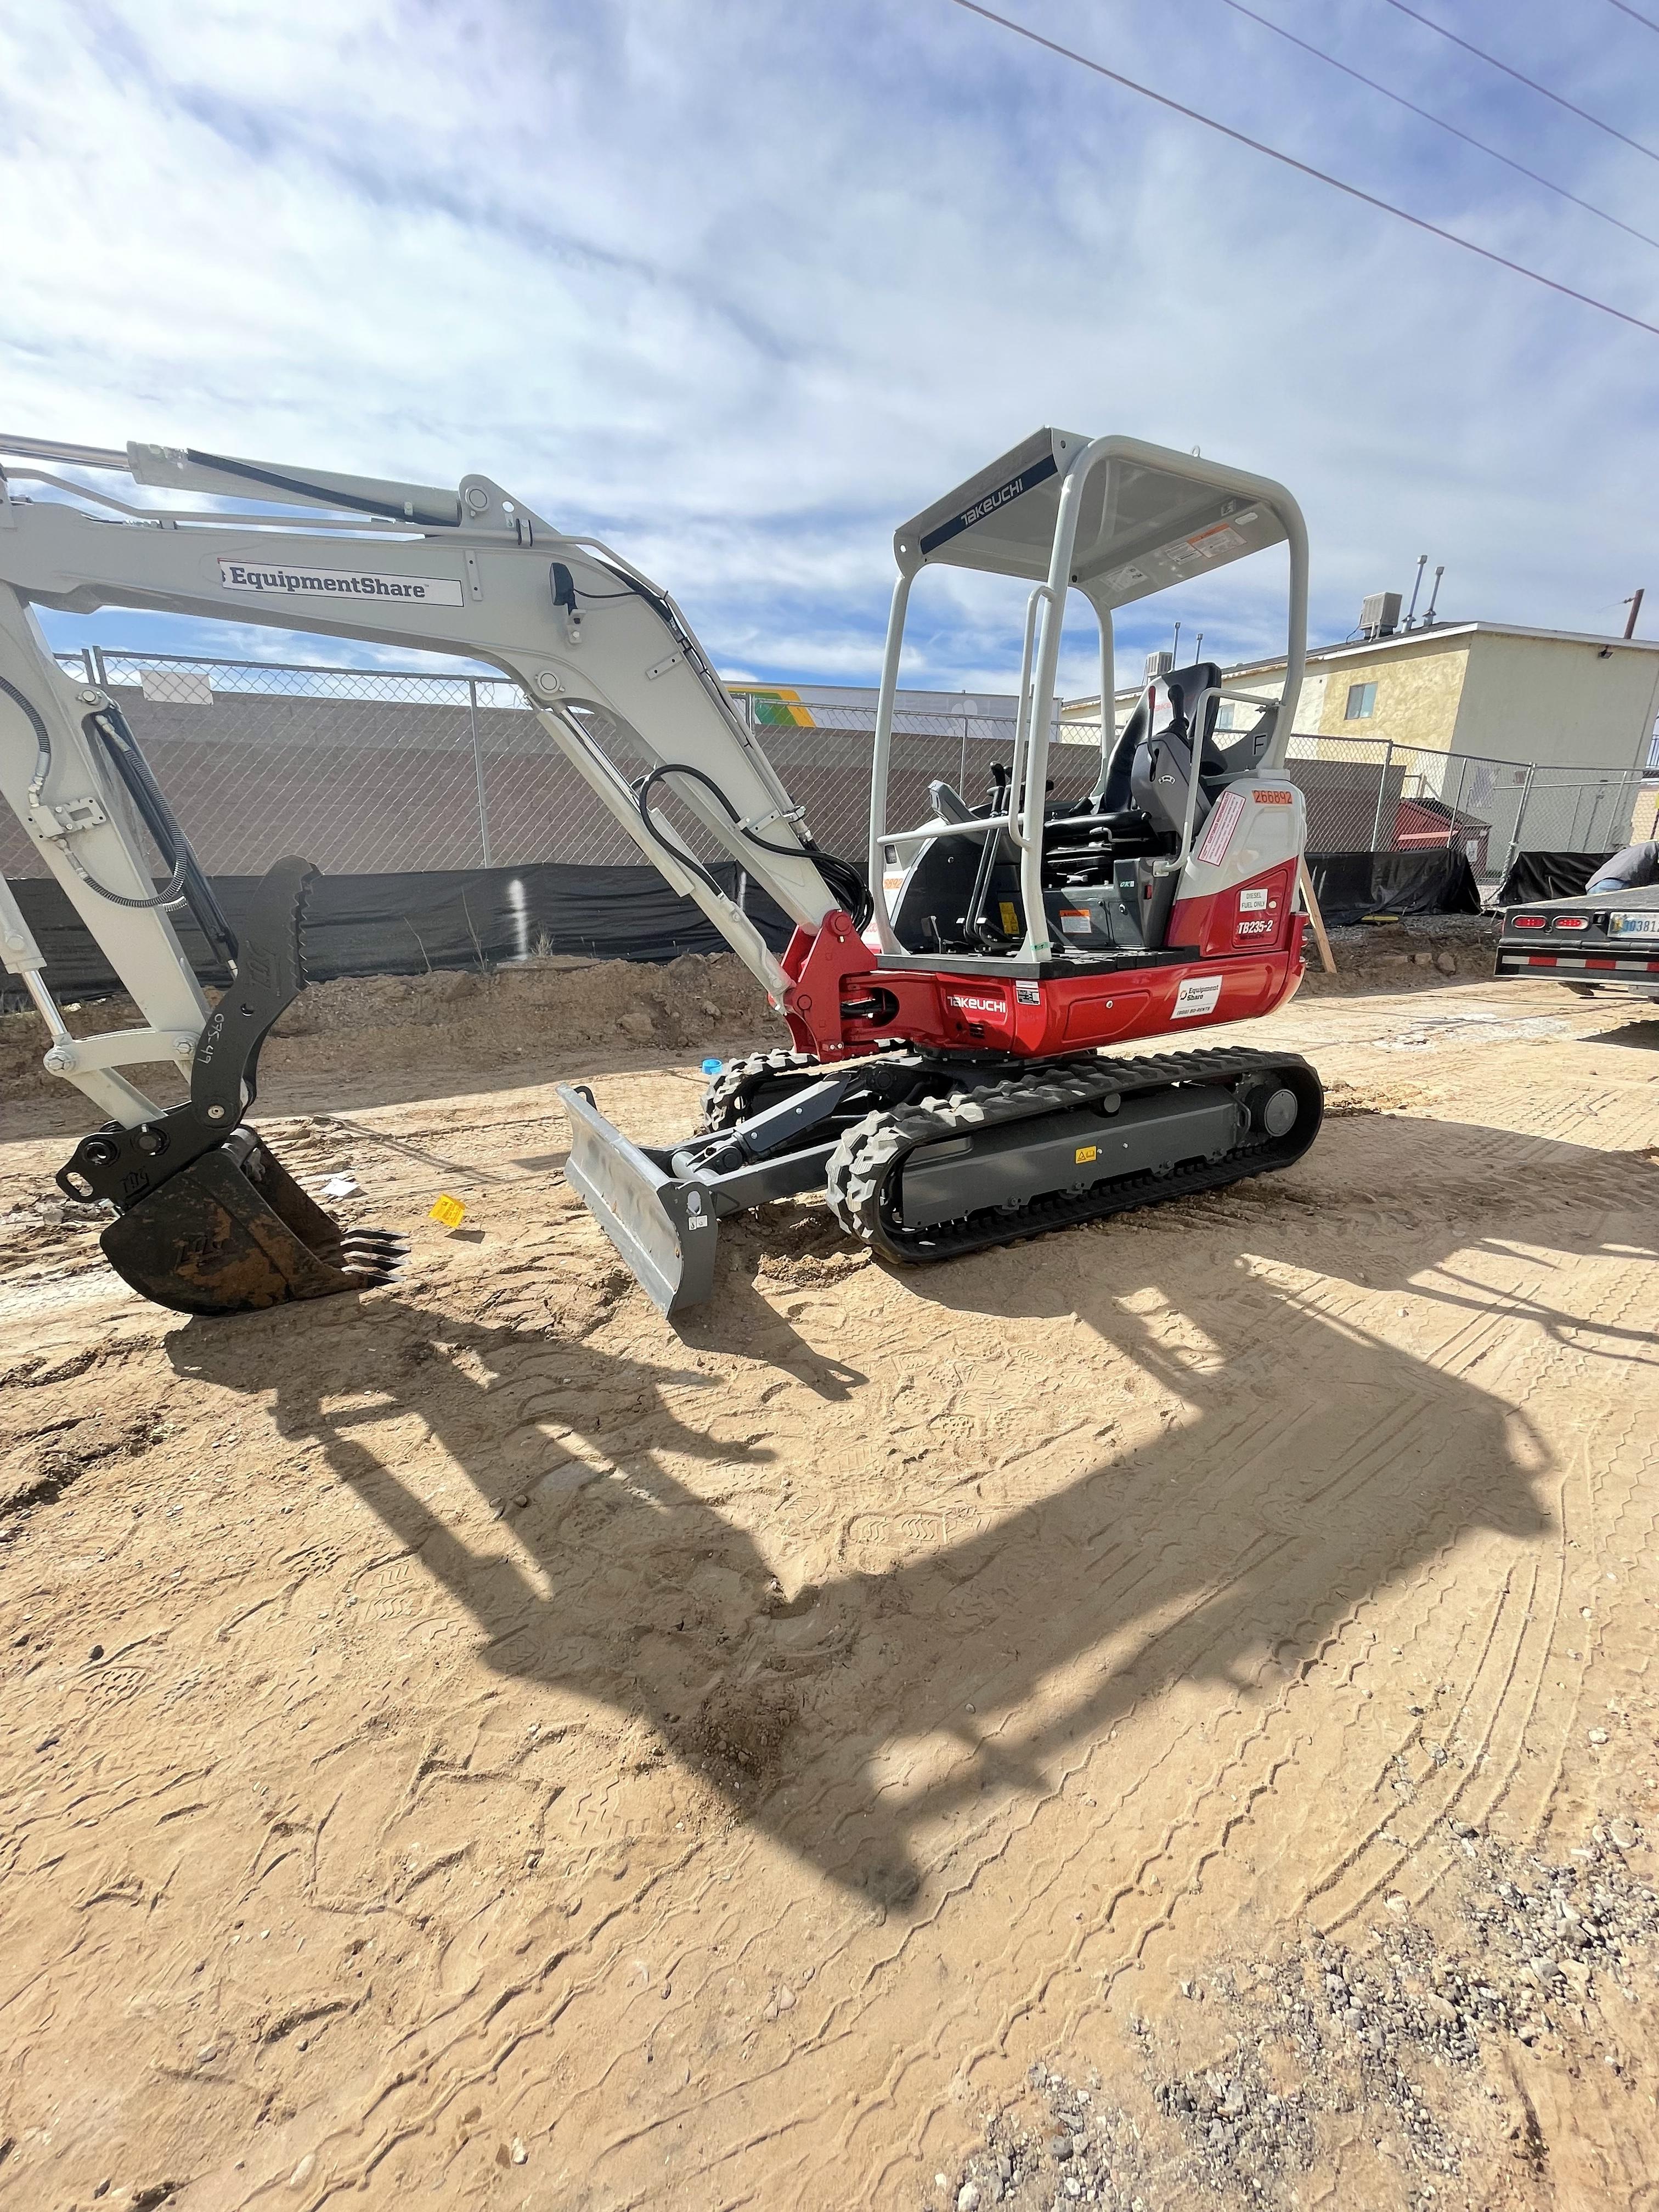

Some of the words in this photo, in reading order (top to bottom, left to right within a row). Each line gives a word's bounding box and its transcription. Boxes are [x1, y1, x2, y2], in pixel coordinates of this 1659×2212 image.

[229, 567, 426, 598] EquipmentShare
[1254, 791, 1293, 804] 266892
[1238, 919, 1273, 934] TB235-2
[1188, 985, 1219, 994] Equipment
